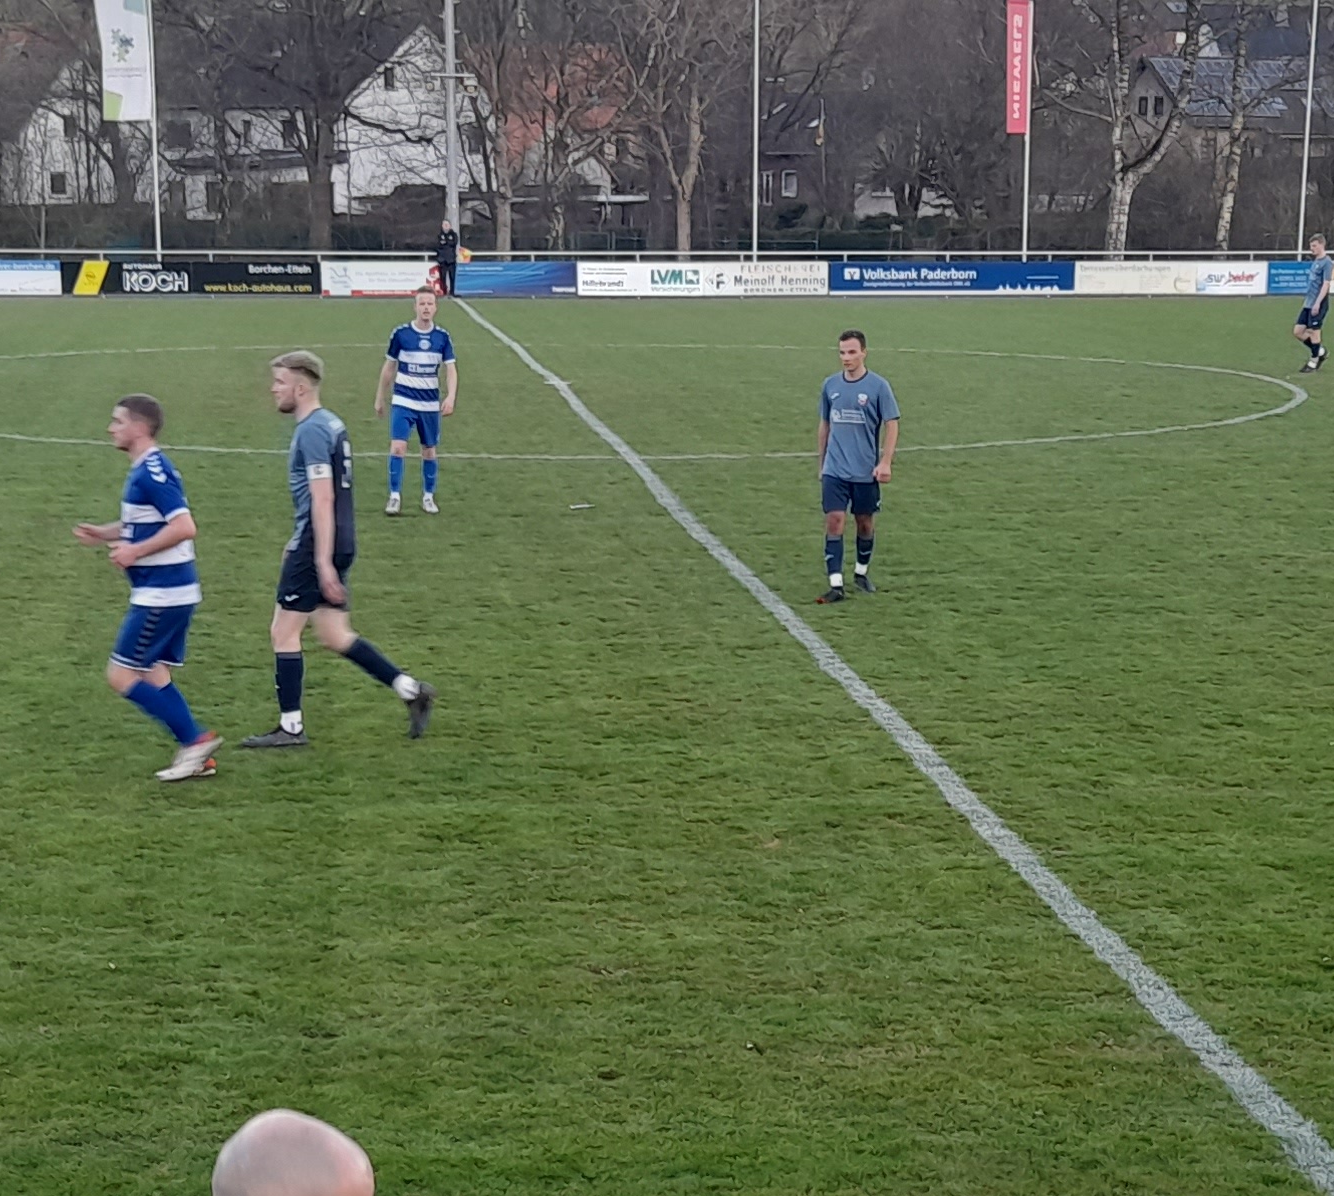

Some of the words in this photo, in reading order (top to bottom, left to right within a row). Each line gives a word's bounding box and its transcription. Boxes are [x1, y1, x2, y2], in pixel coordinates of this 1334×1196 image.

[248, 264, 312, 275] Borchen-Etteln
[740, 264, 821, 274] FLEISCHEREI
[862, 267, 918, 280] Volksbank
[921, 267, 977, 280] Paderborn
[122, 271, 189, 293] KOCH
[650, 269, 684, 285] LVM
[734, 275, 775, 287] Meinolf
[781, 275, 826, 289] Henning
[204, 282, 312, 294] www.koch-autohaus.com
